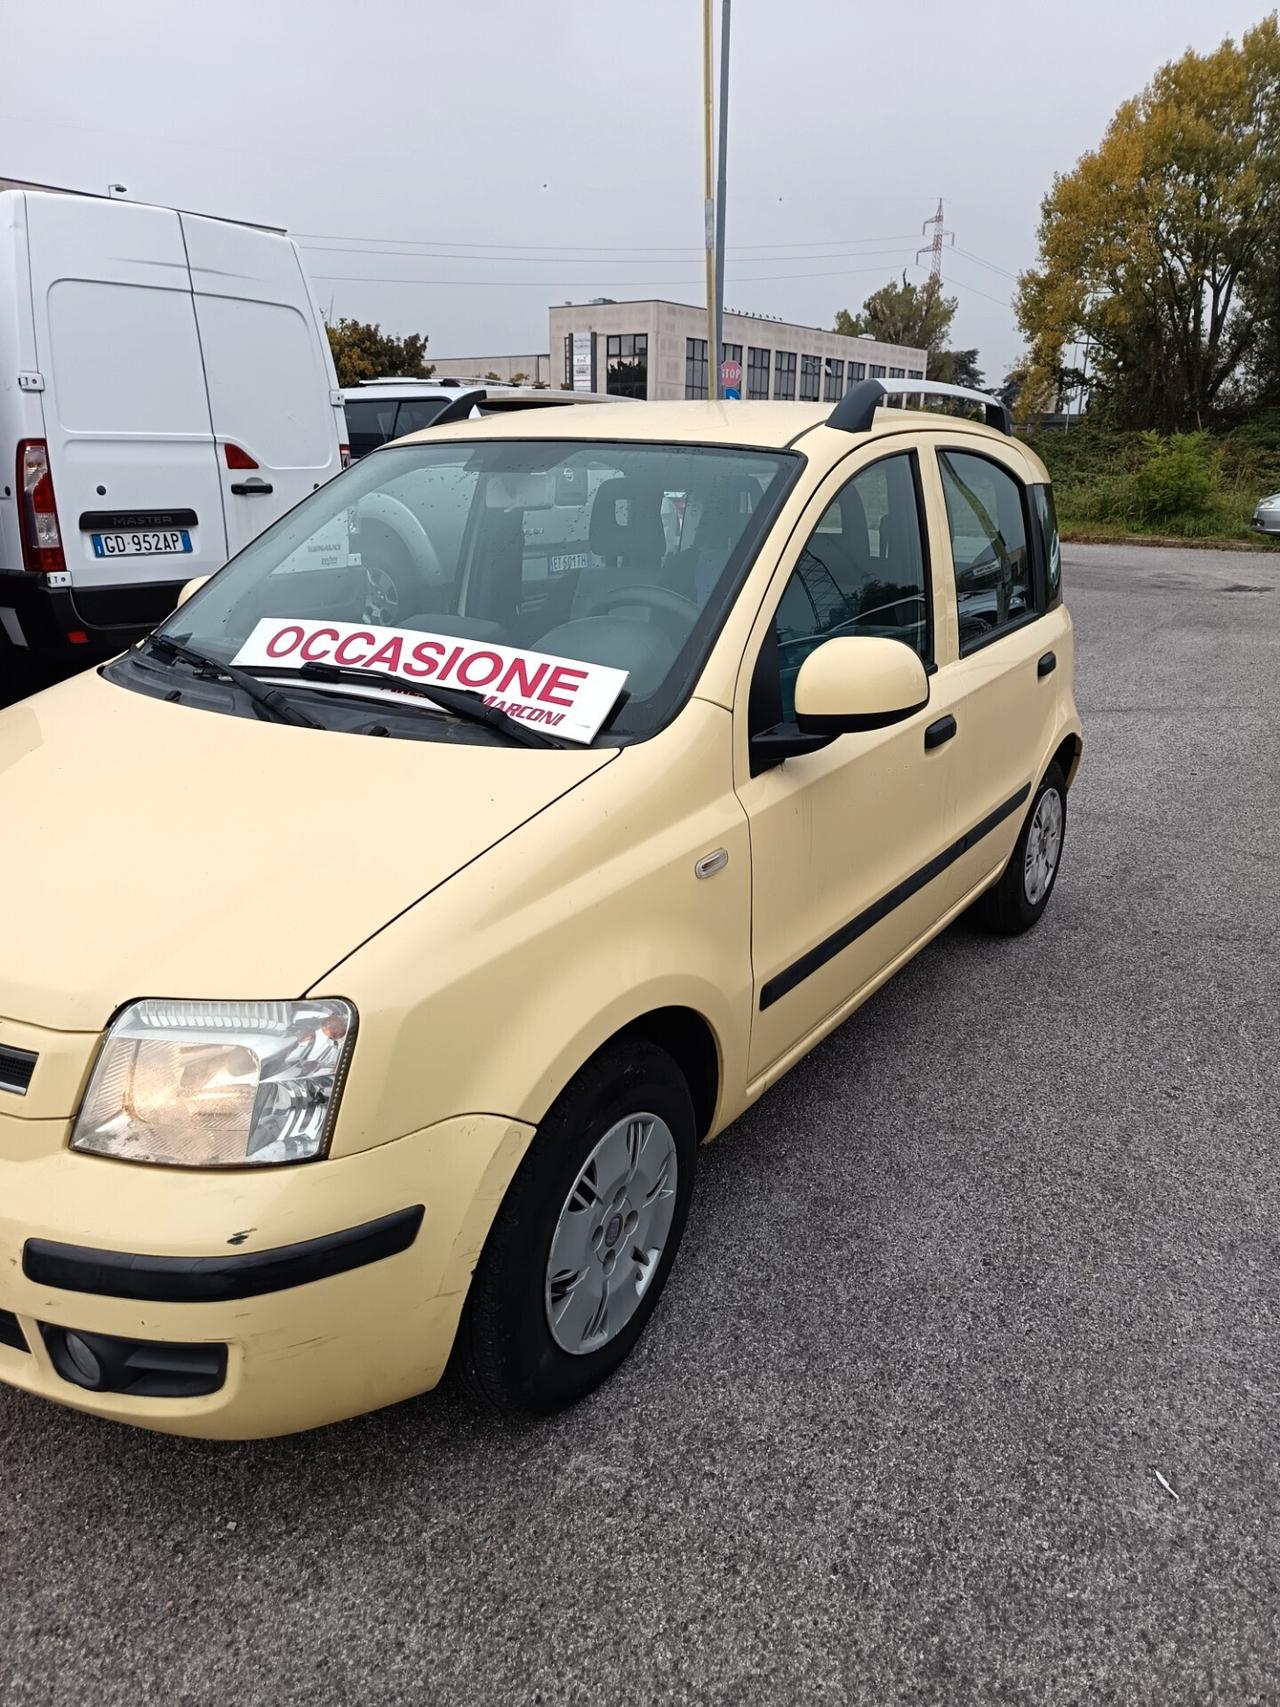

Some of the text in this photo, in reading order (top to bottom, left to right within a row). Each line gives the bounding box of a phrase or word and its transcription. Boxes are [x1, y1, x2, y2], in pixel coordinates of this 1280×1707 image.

[113, 516, 172, 525] MASTER
[266, 625, 589, 707] OCCASIONE
[480, 693, 566, 726] MARCONI
